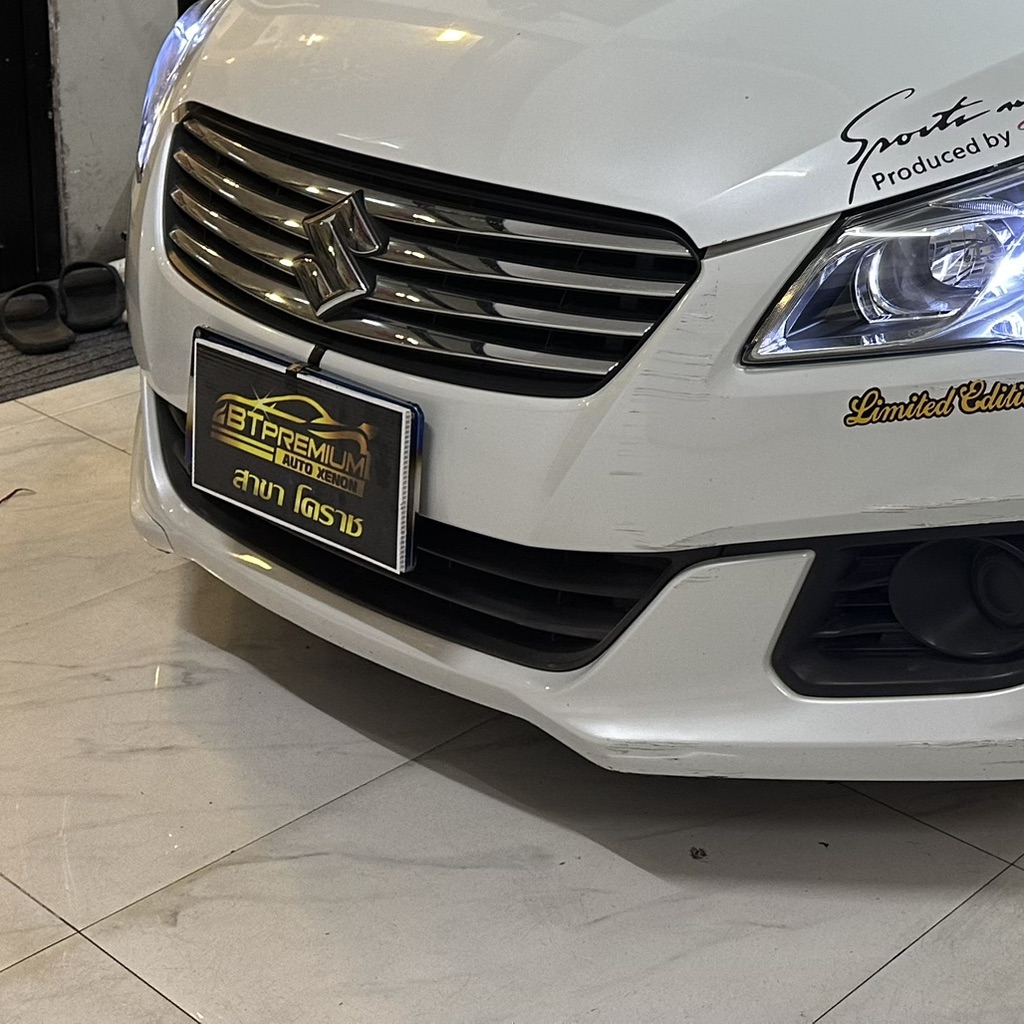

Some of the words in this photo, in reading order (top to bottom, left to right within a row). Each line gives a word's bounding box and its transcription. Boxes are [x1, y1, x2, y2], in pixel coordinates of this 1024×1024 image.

[871, 137, 981, 191] Produced
[982, 130, 1012, 148] by
[844, 387, 957, 426] Limited
[282, 454, 313, 475] AUTO
[316, 467, 358, 494] XENON
[232, 468, 285, 507] สาขา
[293, 484, 365, 538] โคราช
